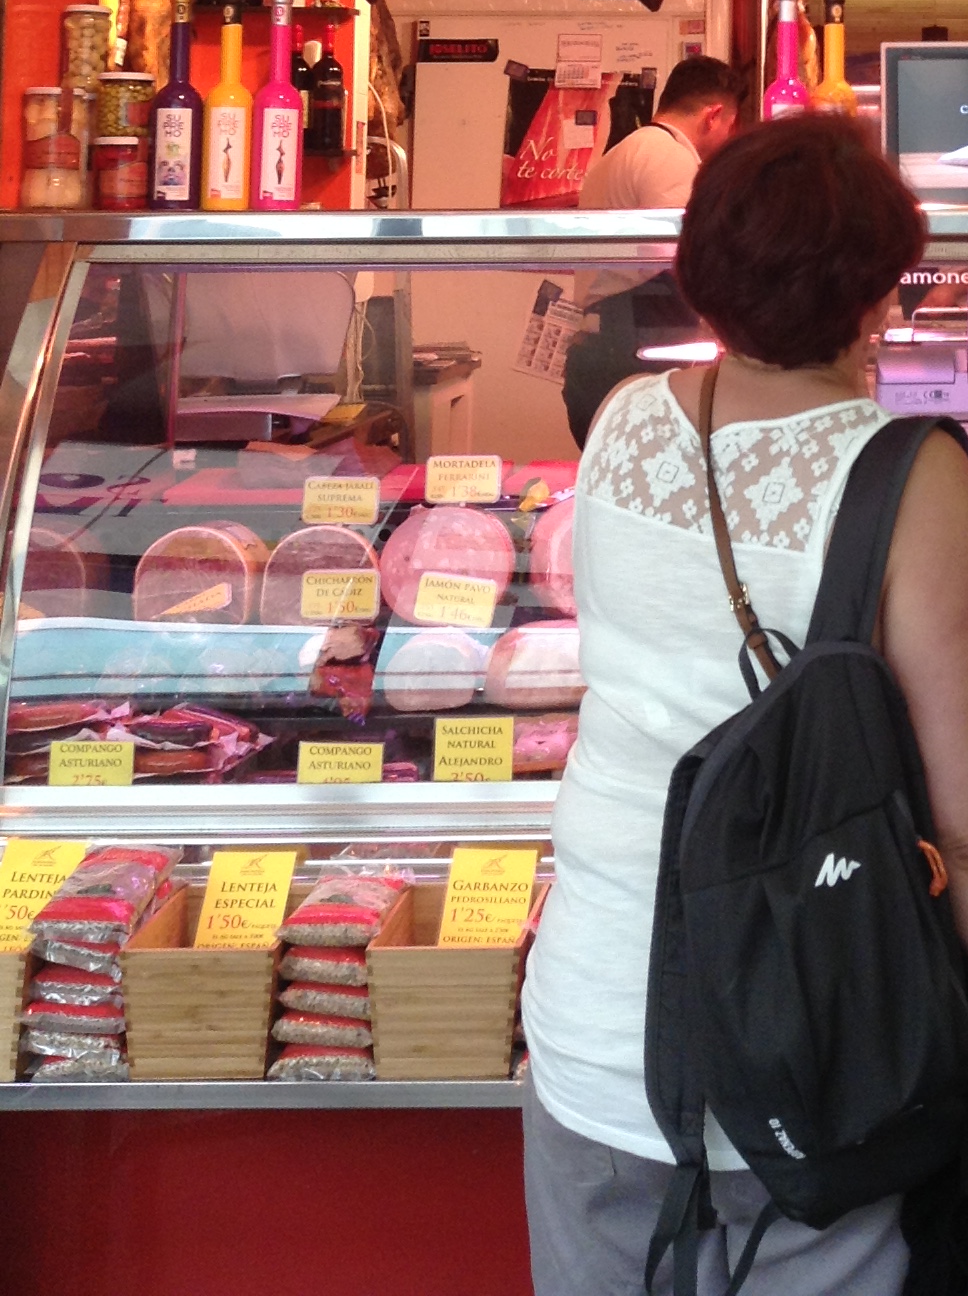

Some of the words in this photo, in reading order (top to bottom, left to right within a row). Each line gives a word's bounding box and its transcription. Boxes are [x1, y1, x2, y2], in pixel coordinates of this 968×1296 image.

[519, 137, 554, 161] No
[516, 160, 537, 179] te
[540, 164, 588, 181] corte
[441, 725, 503, 735] SALCHICHA
[60, 744, 123, 753] COMPANGO
[447, 740, 496, 749] NATURAL
[309, 746, 372, 756] COMPANGO
[59, 758, 122, 768] ASTURIANO
[309, 761, 371, 770] ASTURIANO
[438, 756, 503, 767] ALEJANDRO
[11, 871, 67, 885] LENTEJA
[220, 881, 278, 894] LENTEJA
[452, 879, 529, 892] GARBANZO
[2, 888, 57, 899] PARDIN
[214, 898, 276, 909] ESPECIAL
[4, 904, 36, 920] '50€
[486, 935, 515, 944] ESPAÑ
